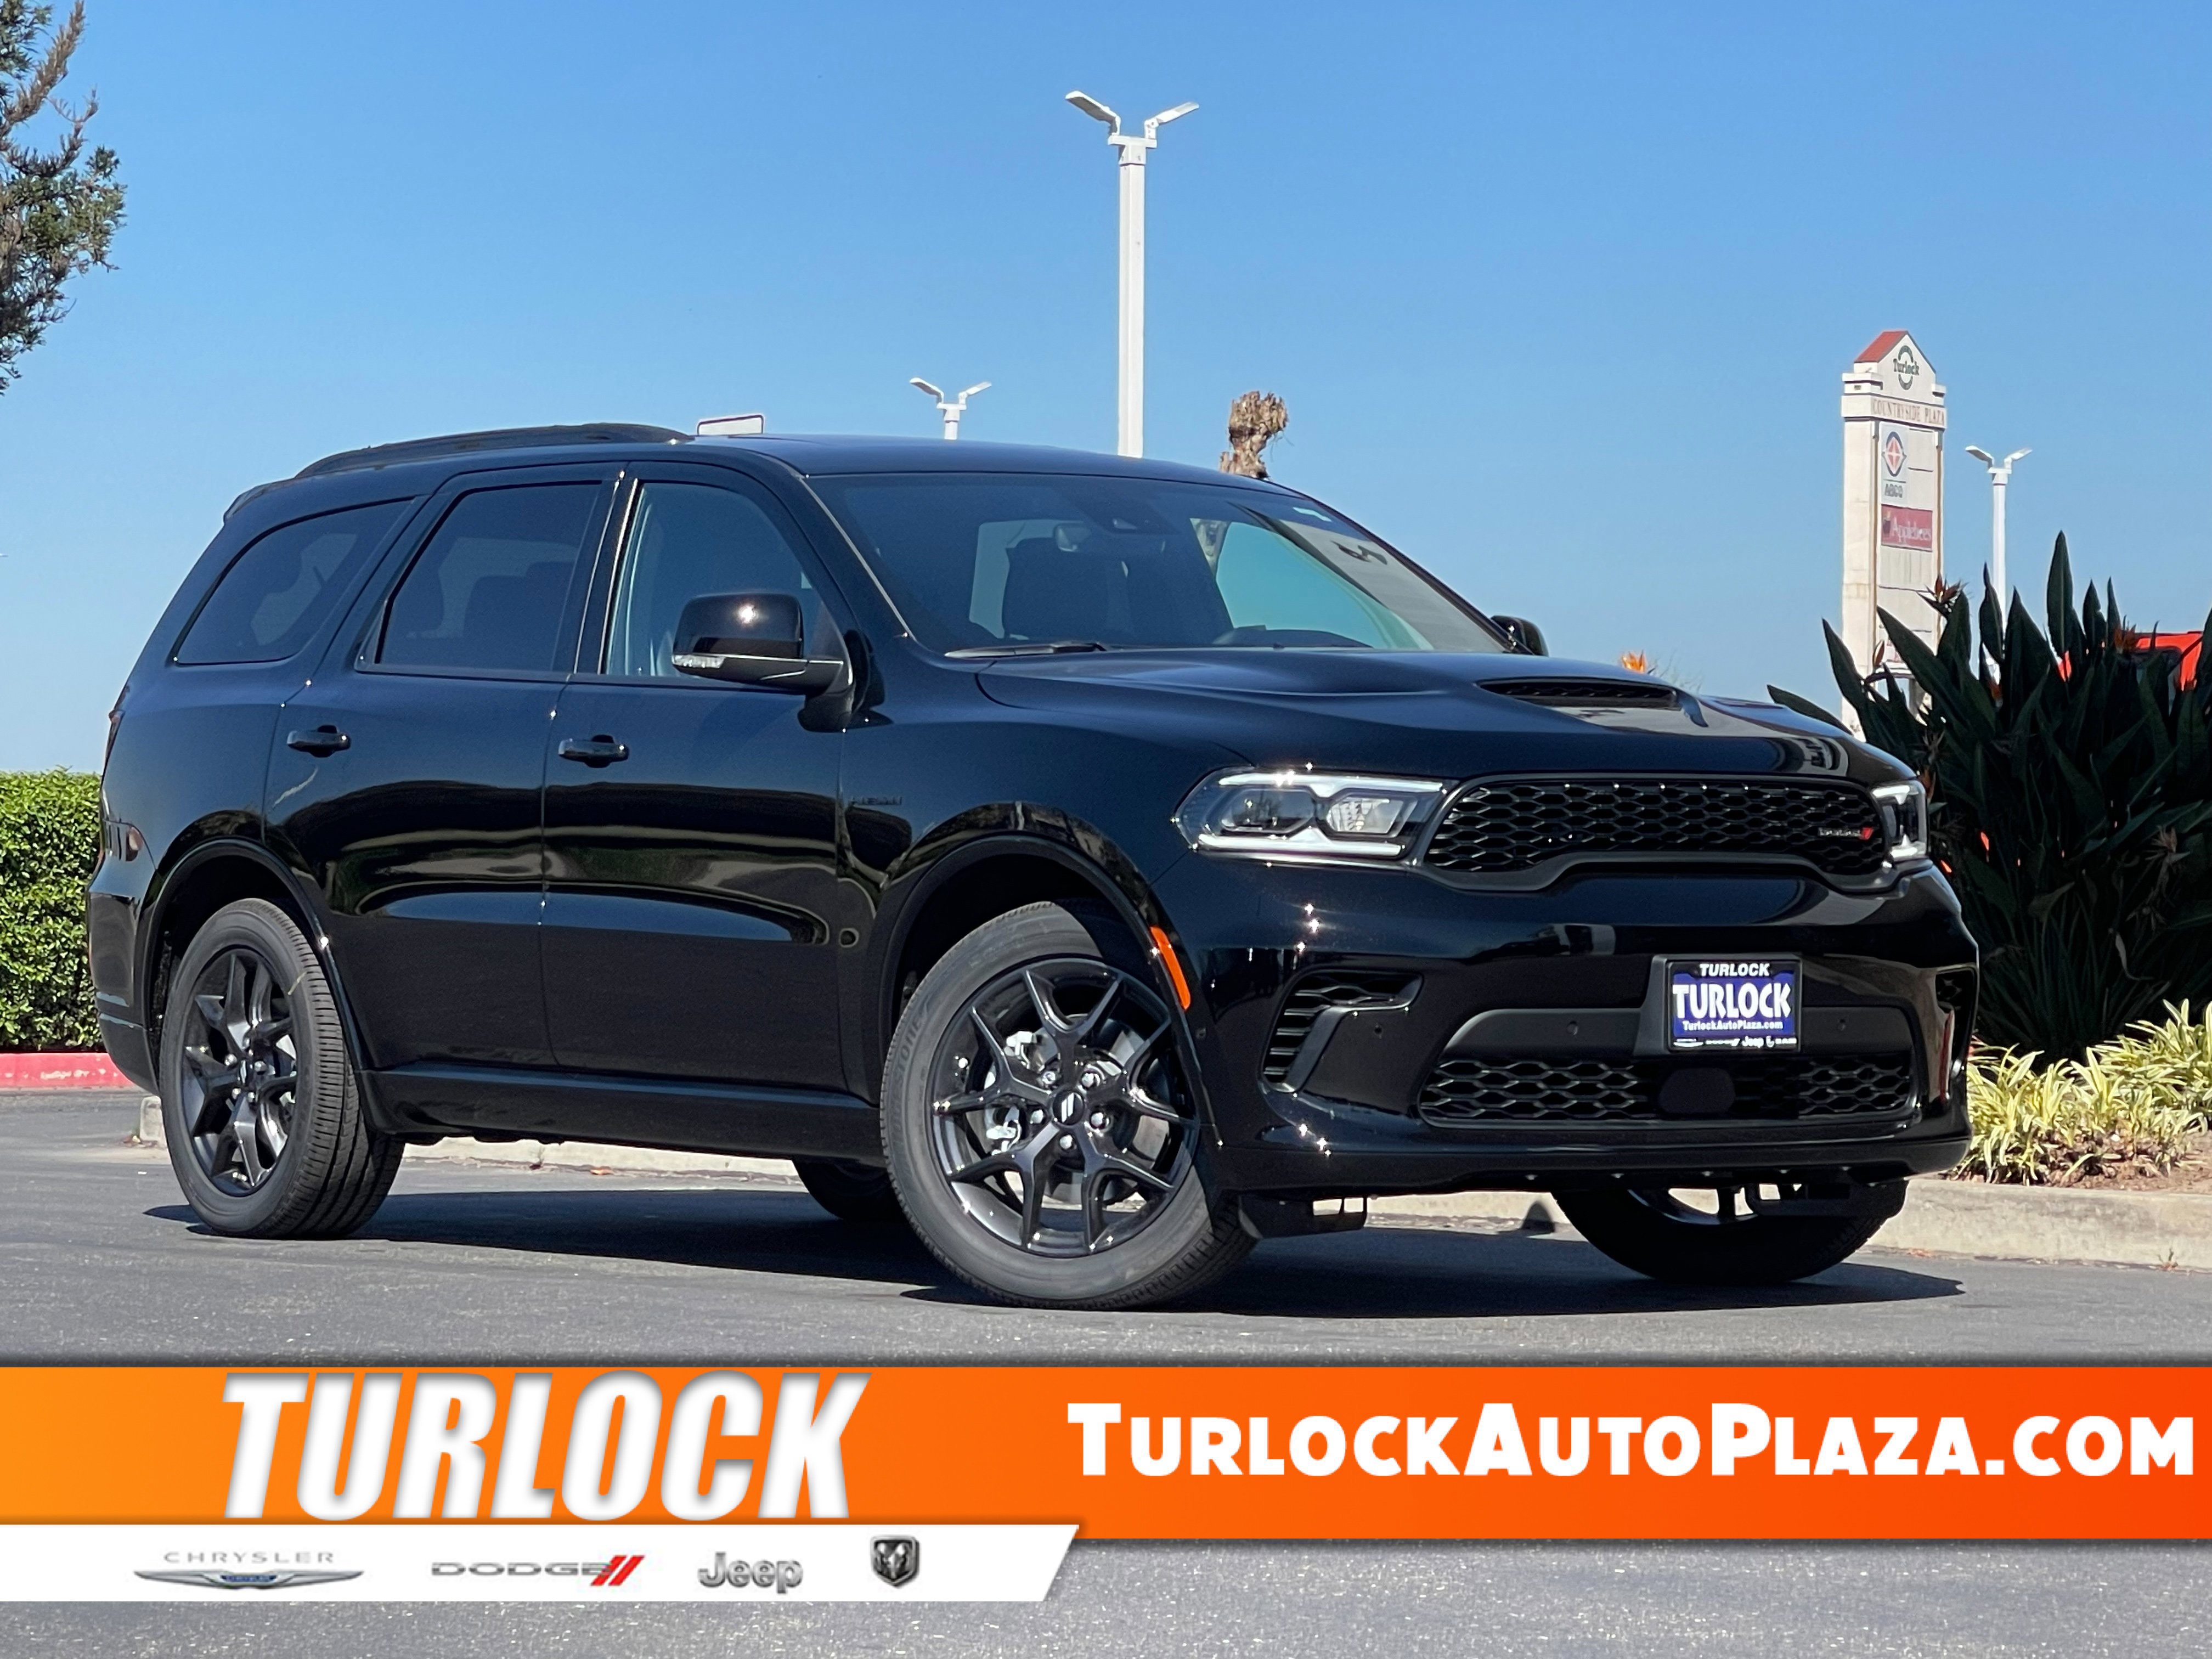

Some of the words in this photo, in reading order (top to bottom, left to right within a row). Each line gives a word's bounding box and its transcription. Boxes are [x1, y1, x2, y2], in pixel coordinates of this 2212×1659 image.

[1893, 358, 1920, 376] Turlock
[1872, 399, 1921, 422] COUNTRYSIDE
[1925, 408, 1945, 426] PLAZA
[1700, 963, 1770, 977] TURLOCK
[1672, 983, 1791, 1019] TURLOCK
[1682, 1020, 1784, 1031] TurlockAutoPlaza.com
